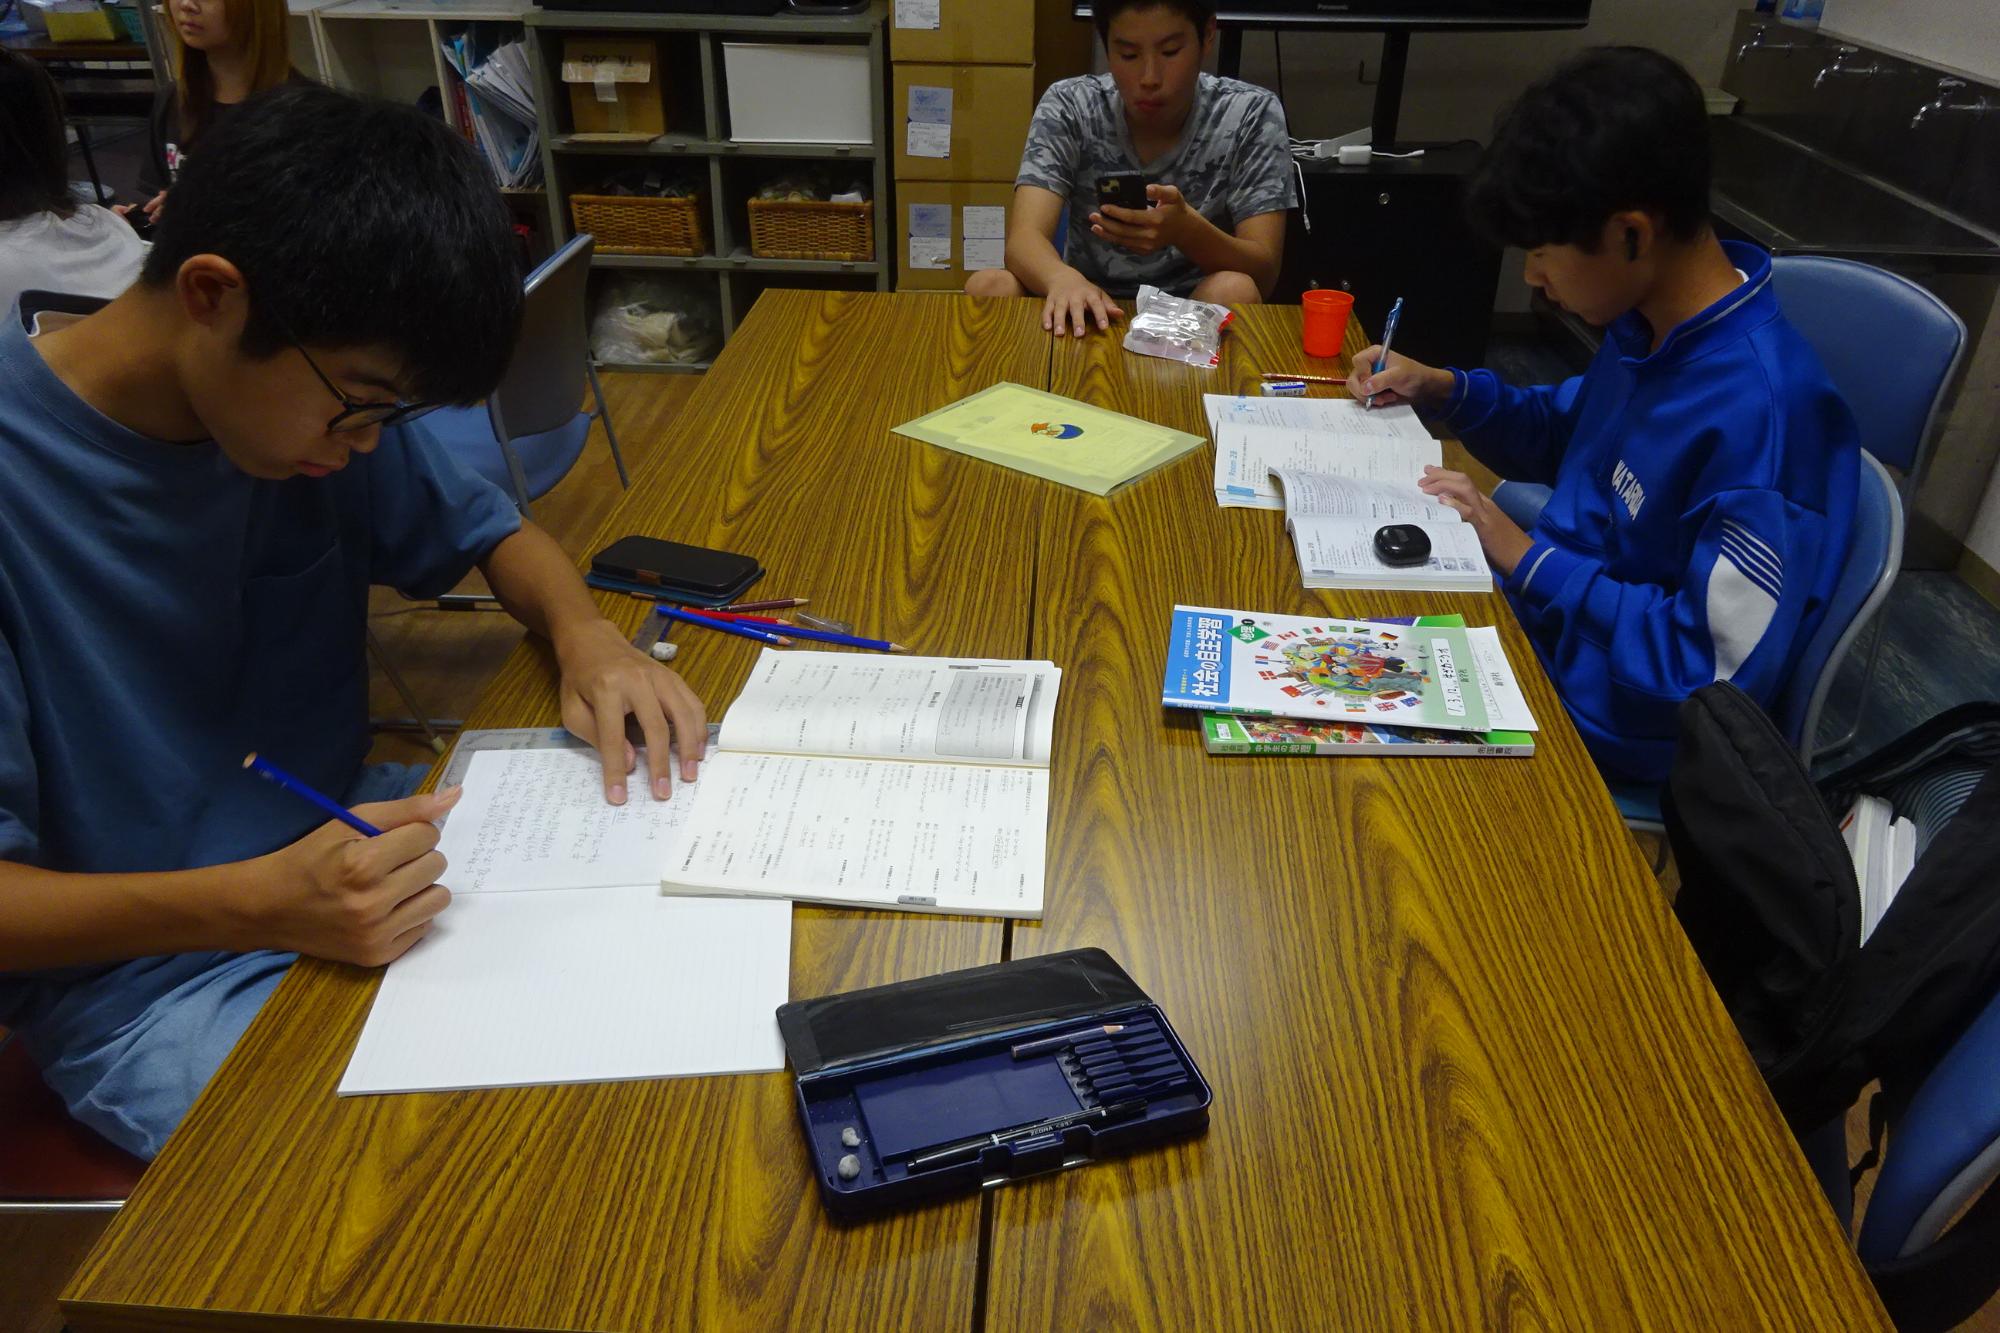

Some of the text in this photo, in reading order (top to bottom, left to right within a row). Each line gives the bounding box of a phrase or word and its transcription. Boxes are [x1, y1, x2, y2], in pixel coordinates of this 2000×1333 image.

[1192, 617, 1222, 696] 社会の自主学習
